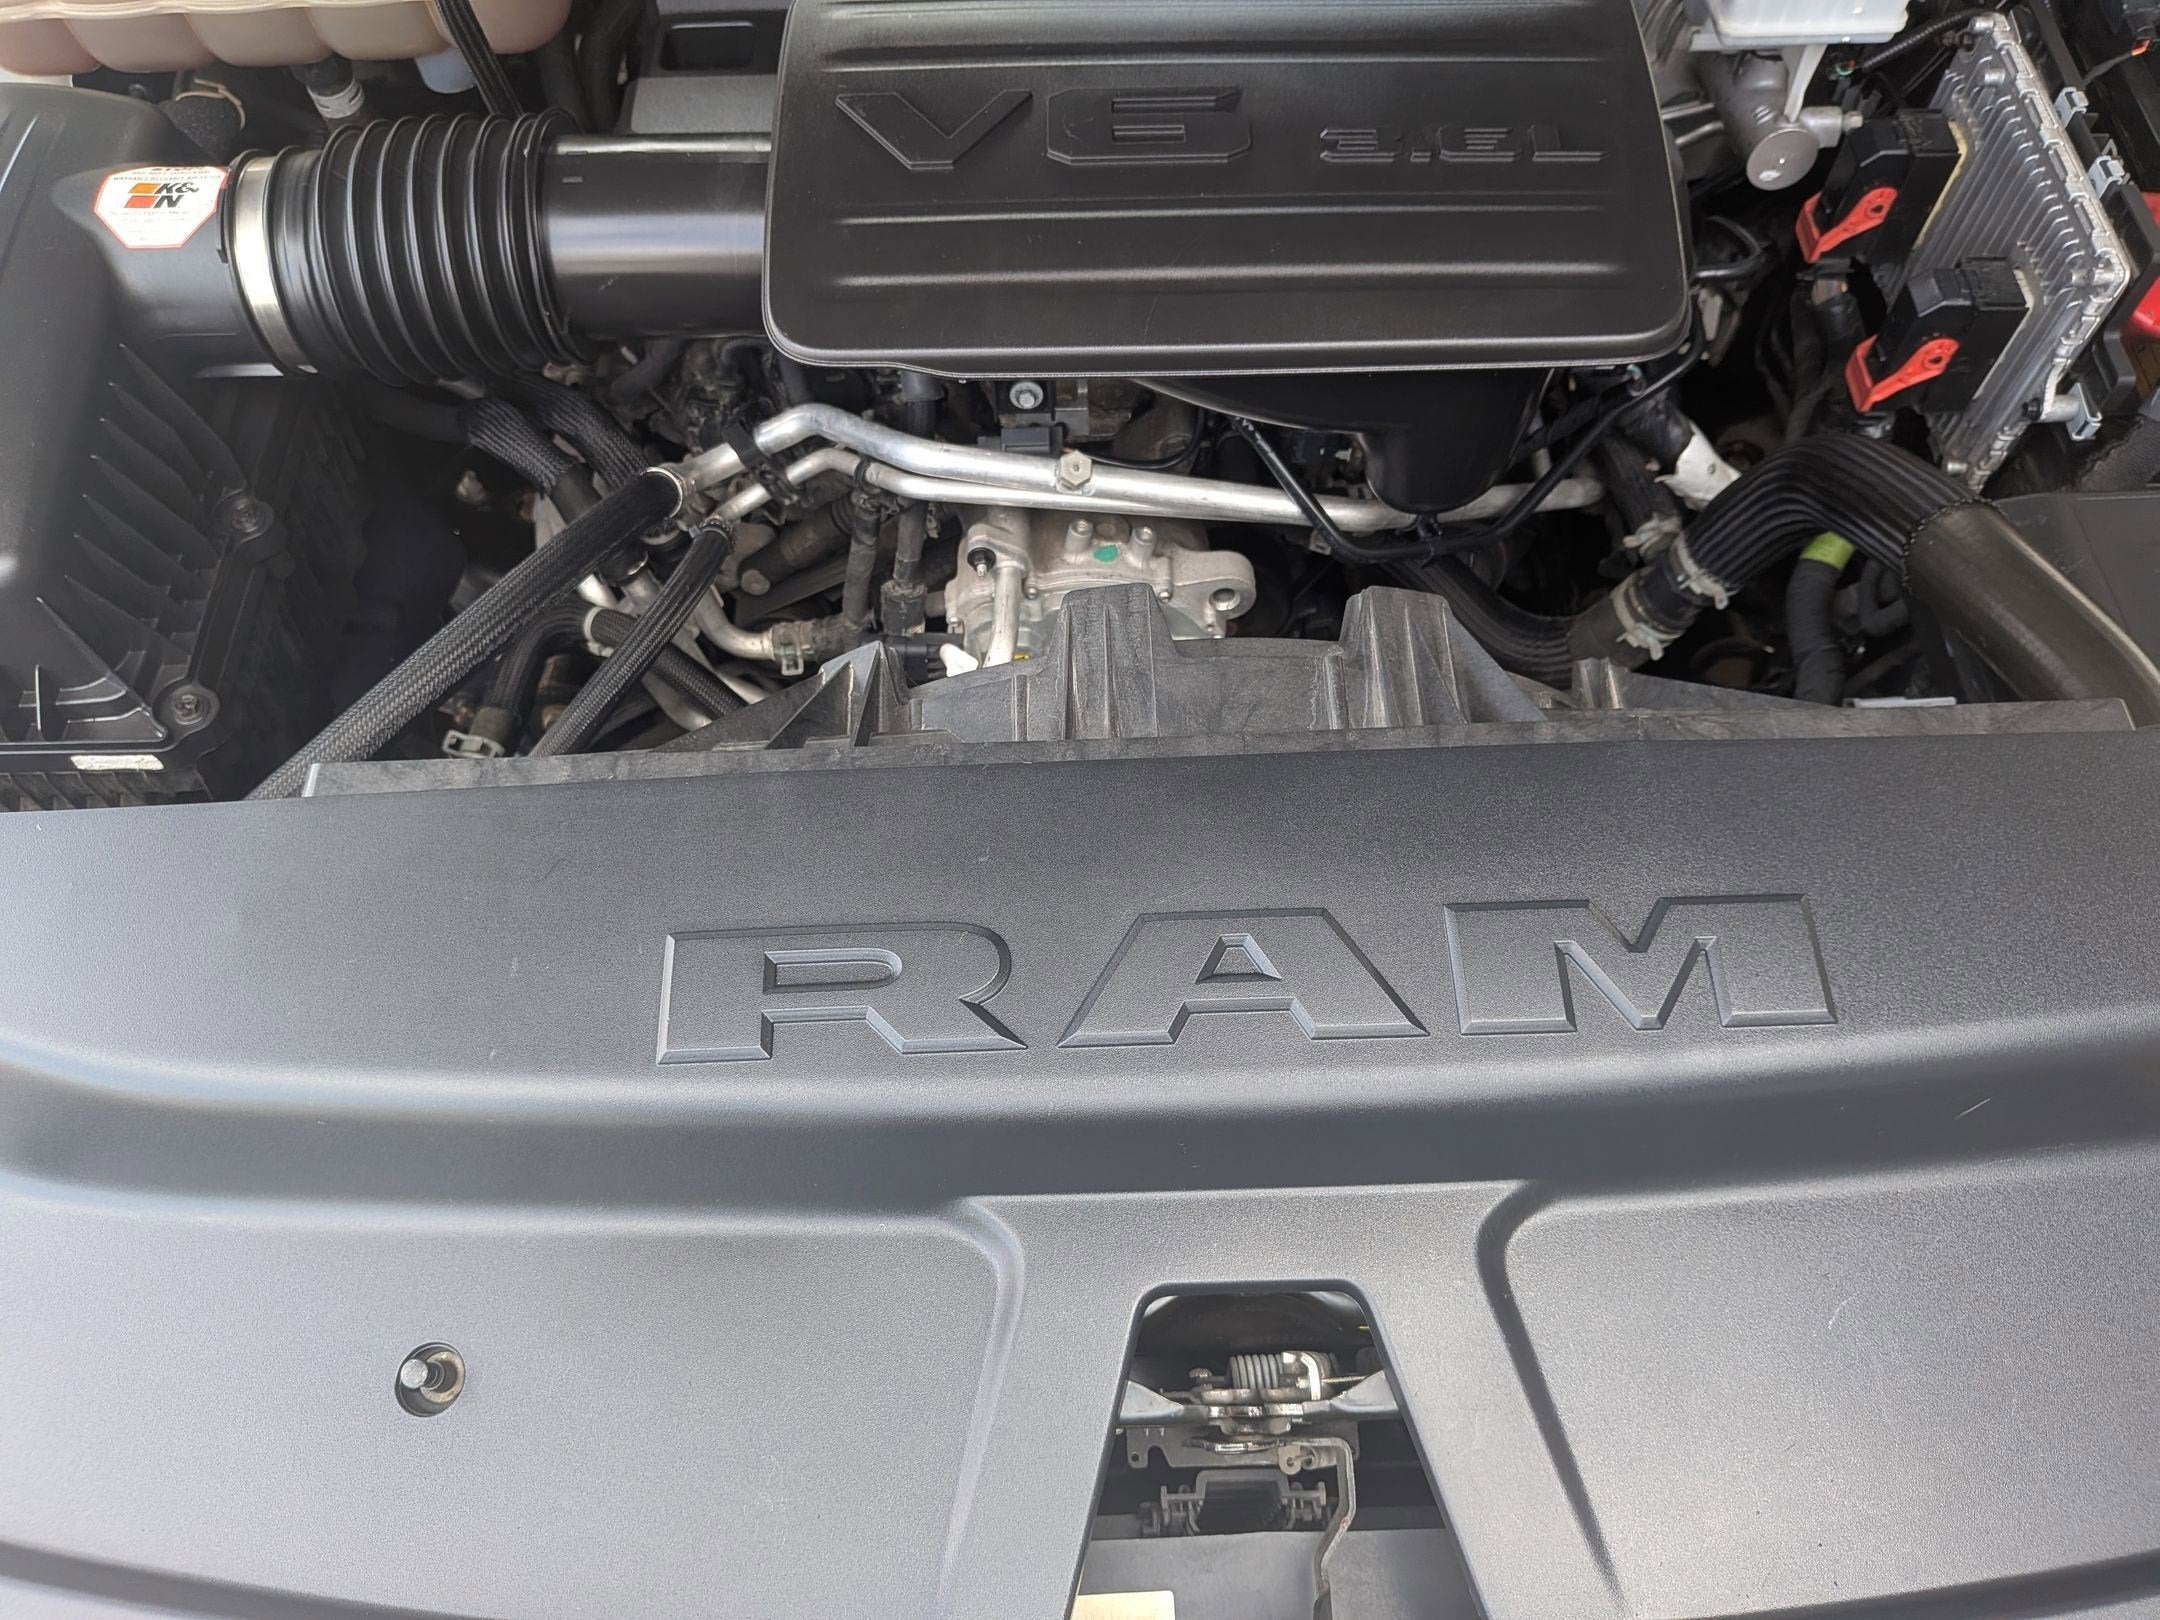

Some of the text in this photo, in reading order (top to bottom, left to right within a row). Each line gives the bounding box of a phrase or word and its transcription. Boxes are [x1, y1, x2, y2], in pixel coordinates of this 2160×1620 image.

[835, 86, 1608, 170] V6 3.6L
[654, 891, 1840, 1065] RAM
